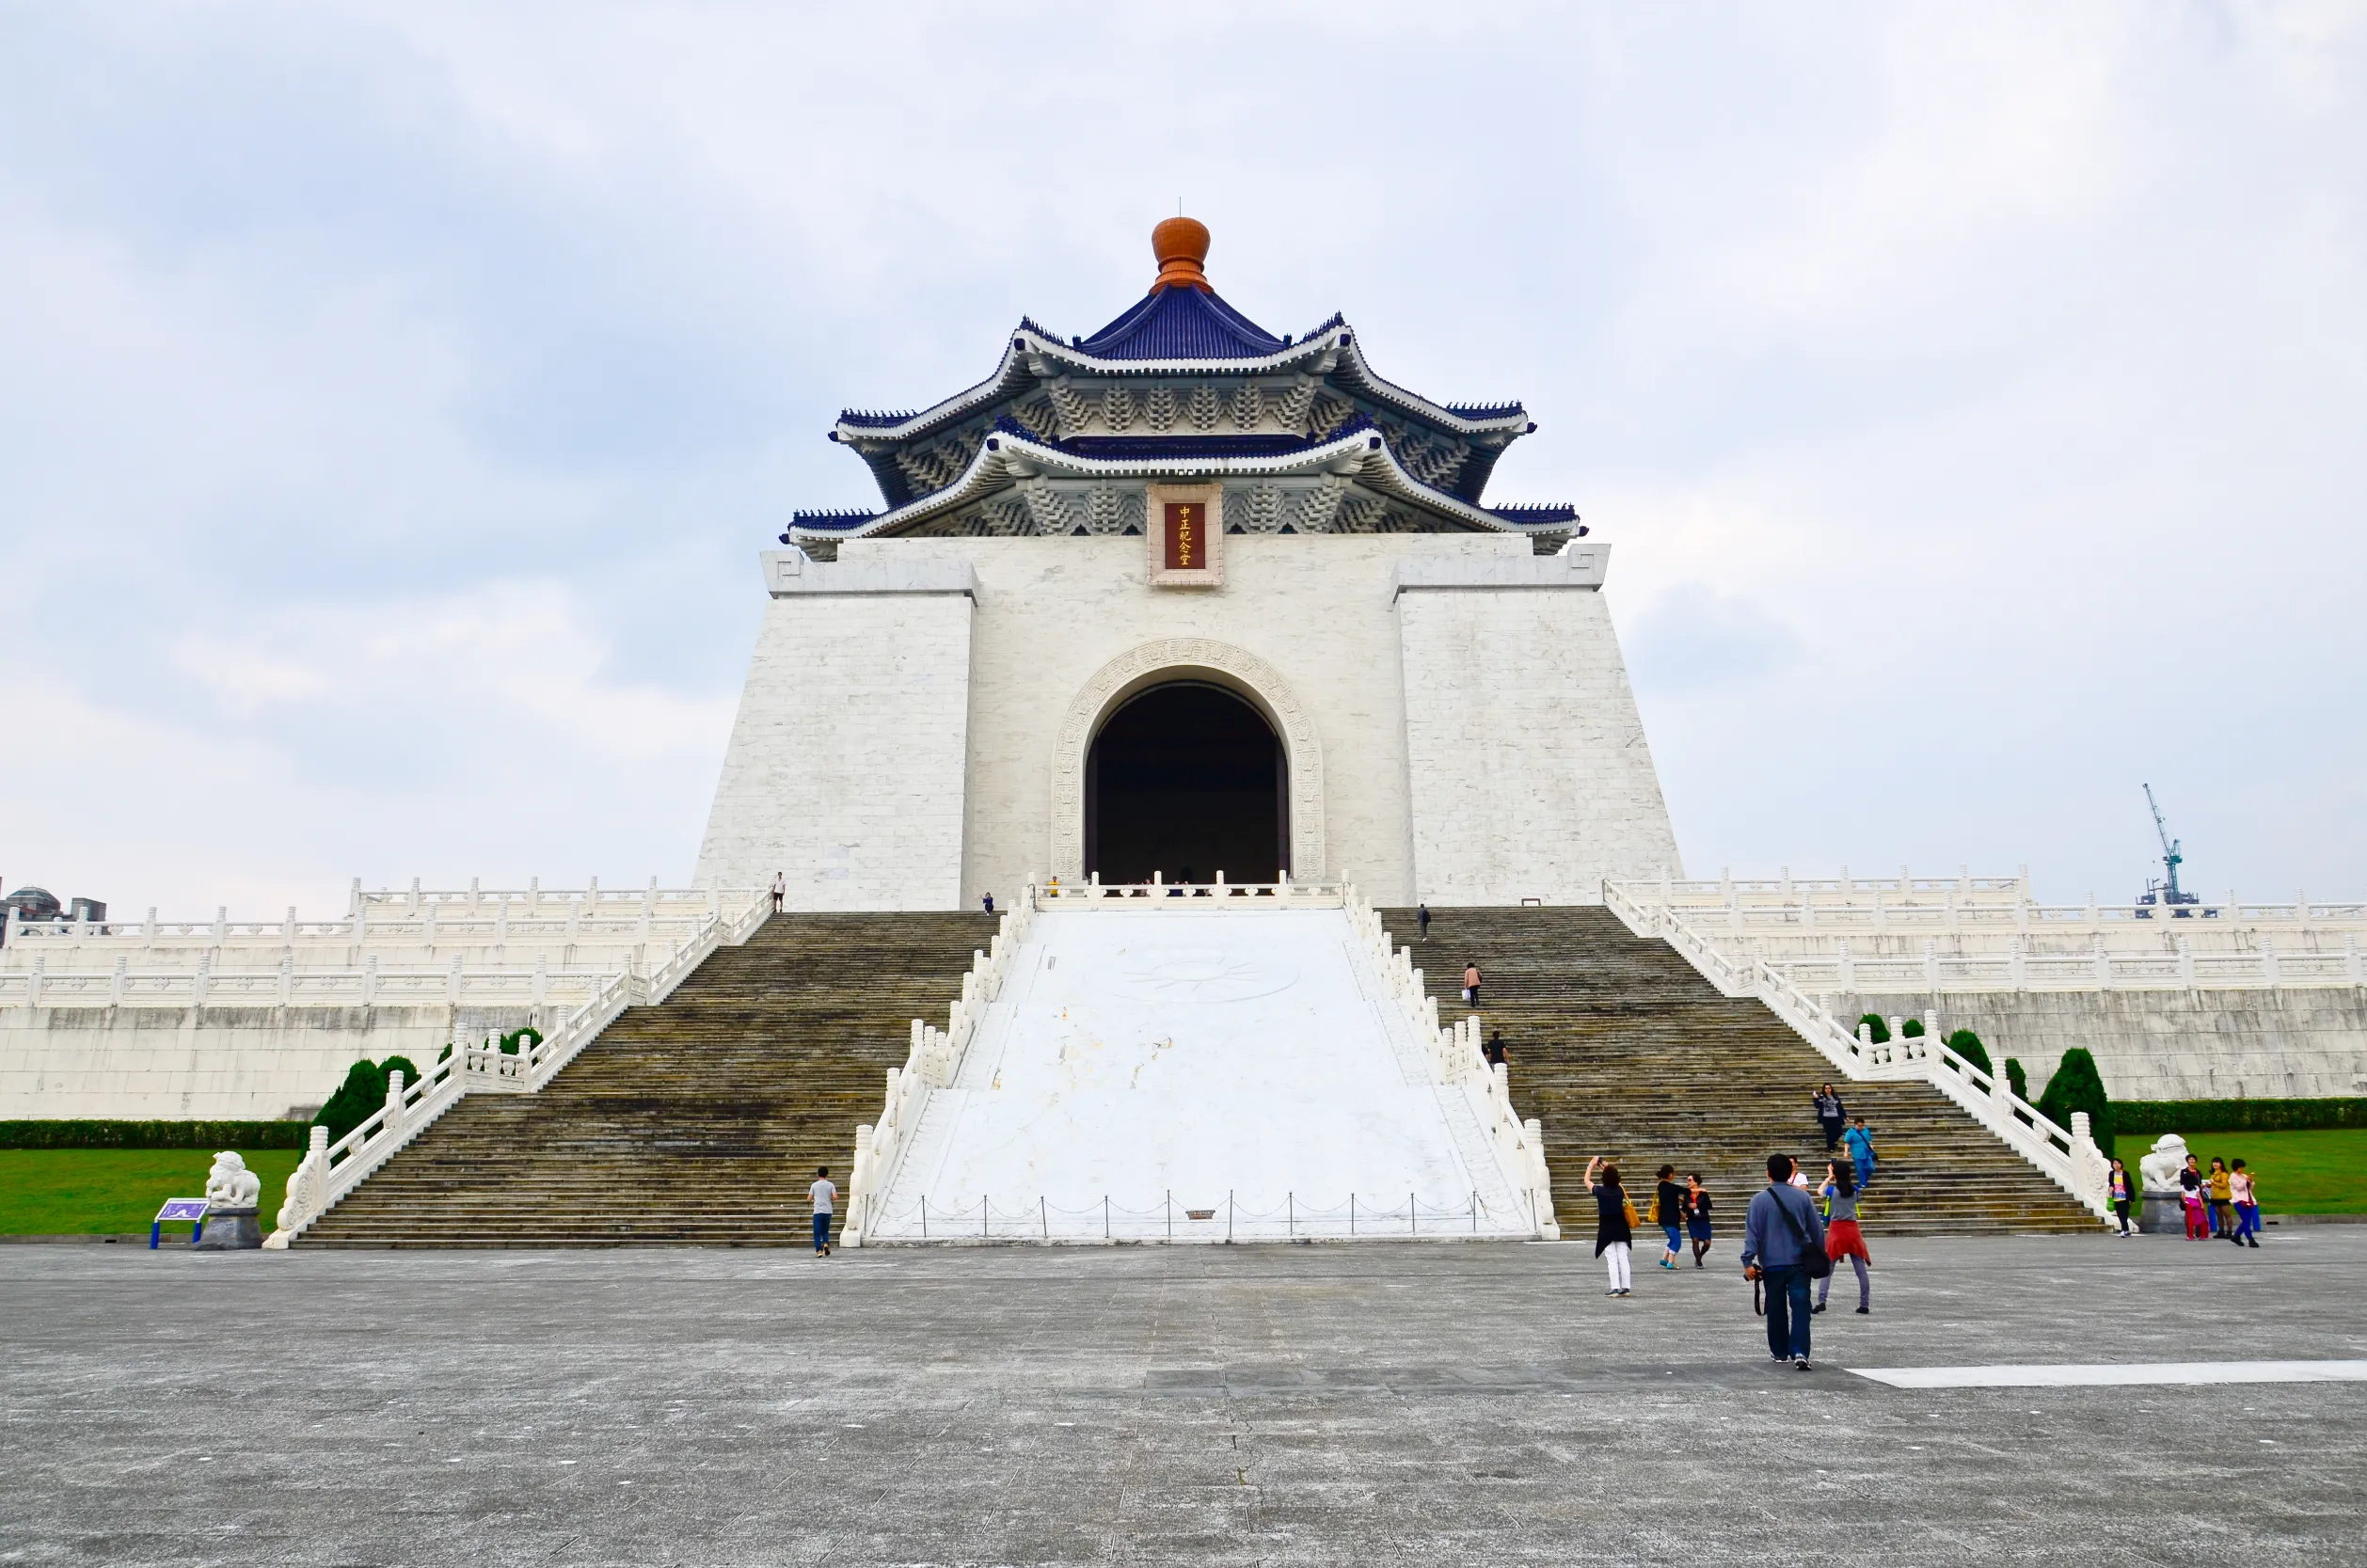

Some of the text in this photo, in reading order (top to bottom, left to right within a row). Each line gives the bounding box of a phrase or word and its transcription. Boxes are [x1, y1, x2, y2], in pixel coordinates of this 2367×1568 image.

[1179, 506, 1192, 565] 中正紀念堂
